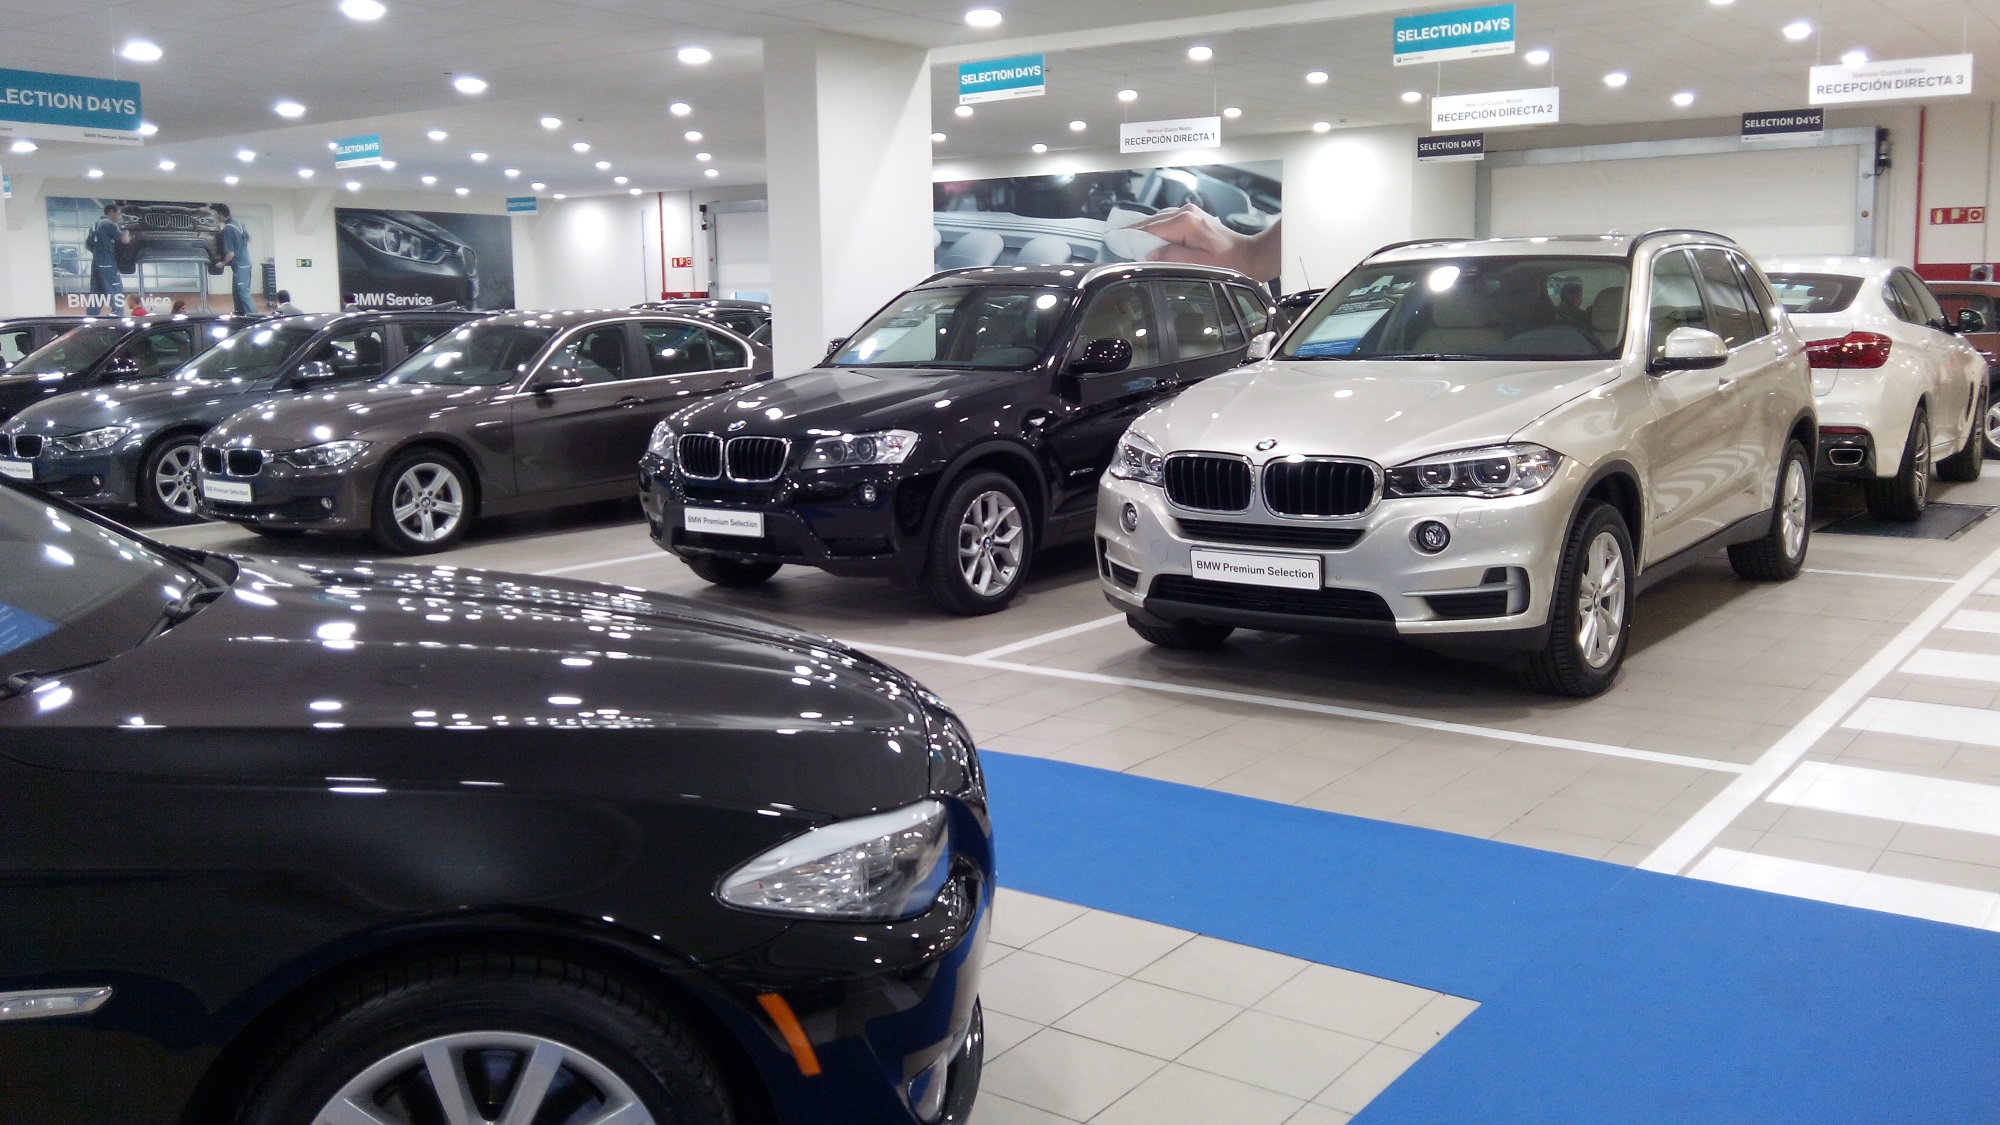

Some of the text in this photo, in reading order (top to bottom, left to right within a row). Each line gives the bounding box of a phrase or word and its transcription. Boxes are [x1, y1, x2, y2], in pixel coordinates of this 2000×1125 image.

[1396, 17, 1511, 43] SELECTION D4YS
[961, 65, 1041, 85] SELECTION D4YS
[1816, 74, 1964, 96] RECEPCIÓN DIRECTA 3
[86, 96, 137, 116] D4YS
[1437, 103, 1553, 123] RECEPCIÓN DIRECTA 2
[1744, 114, 1822, 128] SELECTION D4YS
[1124, 132, 1216, 146] RECEPCIÓN DIRECTA 1
[1419, 141, 1460, 152] SELECTION
[67, 293, 171, 309] BMW Svice
[386, 292, 433, 306] Service
[687, 515, 758, 528] BMW Premium Selection
[1196, 560, 1314, 580] BMW Premium Selection
